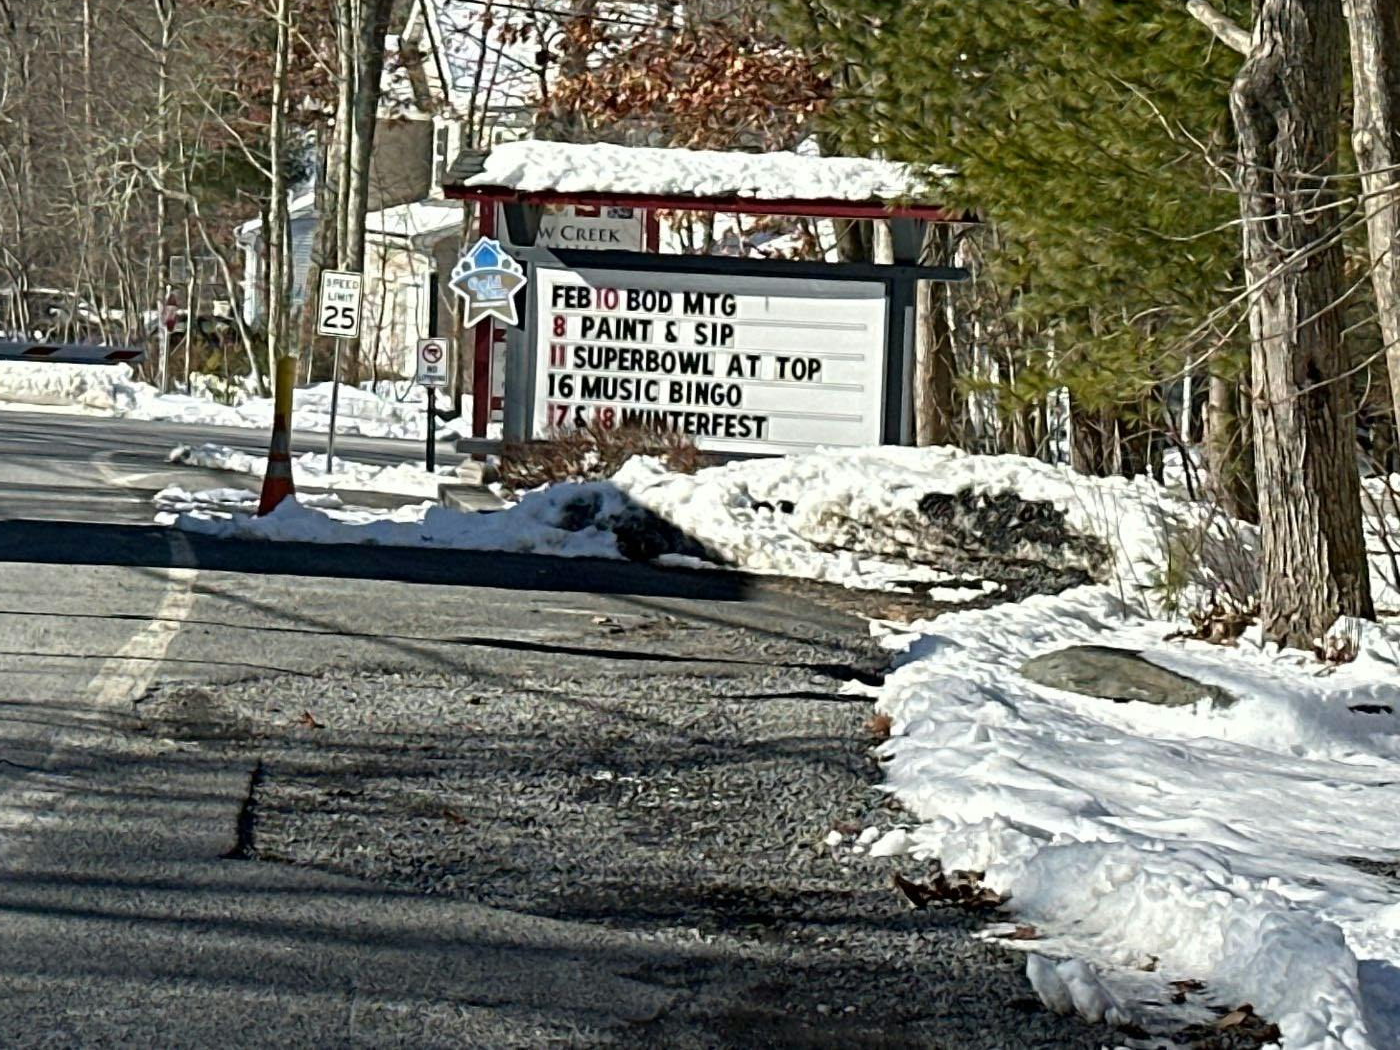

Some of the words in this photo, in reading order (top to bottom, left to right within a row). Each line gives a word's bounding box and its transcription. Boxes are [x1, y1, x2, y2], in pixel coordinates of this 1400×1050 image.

[560, 225, 621, 243] CREEK
[326, 278, 359, 289] SPEED
[328, 292, 354, 302] LIMIT
[551, 284, 591, 309] FEB
[596, 286, 620, 310] 10
[626, 288, 673, 313] BOD
[683, 291, 737, 317] MTG
[323, 305, 355, 329] 25
[553, 314, 566, 337] 8
[581, 316, 653, 342] PAINT
[664, 320, 678, 343] &
[694, 322, 735, 346] SIP
[550, 345, 566, 367] 11
[573, 346, 714, 376] SUPERBOWL
[726, 353, 761, 378] AT
[775, 356, 822, 381] TOP
[548, 373, 574, 398] 16
[580, 375, 660, 402] MUSIC
[669, 380, 743, 407] BINGO
[547, 404, 569, 427] 17
[574, 404, 587, 428] &
[595, 405, 616, 430] 18
[620, 407, 769, 439] WINTERFEST
